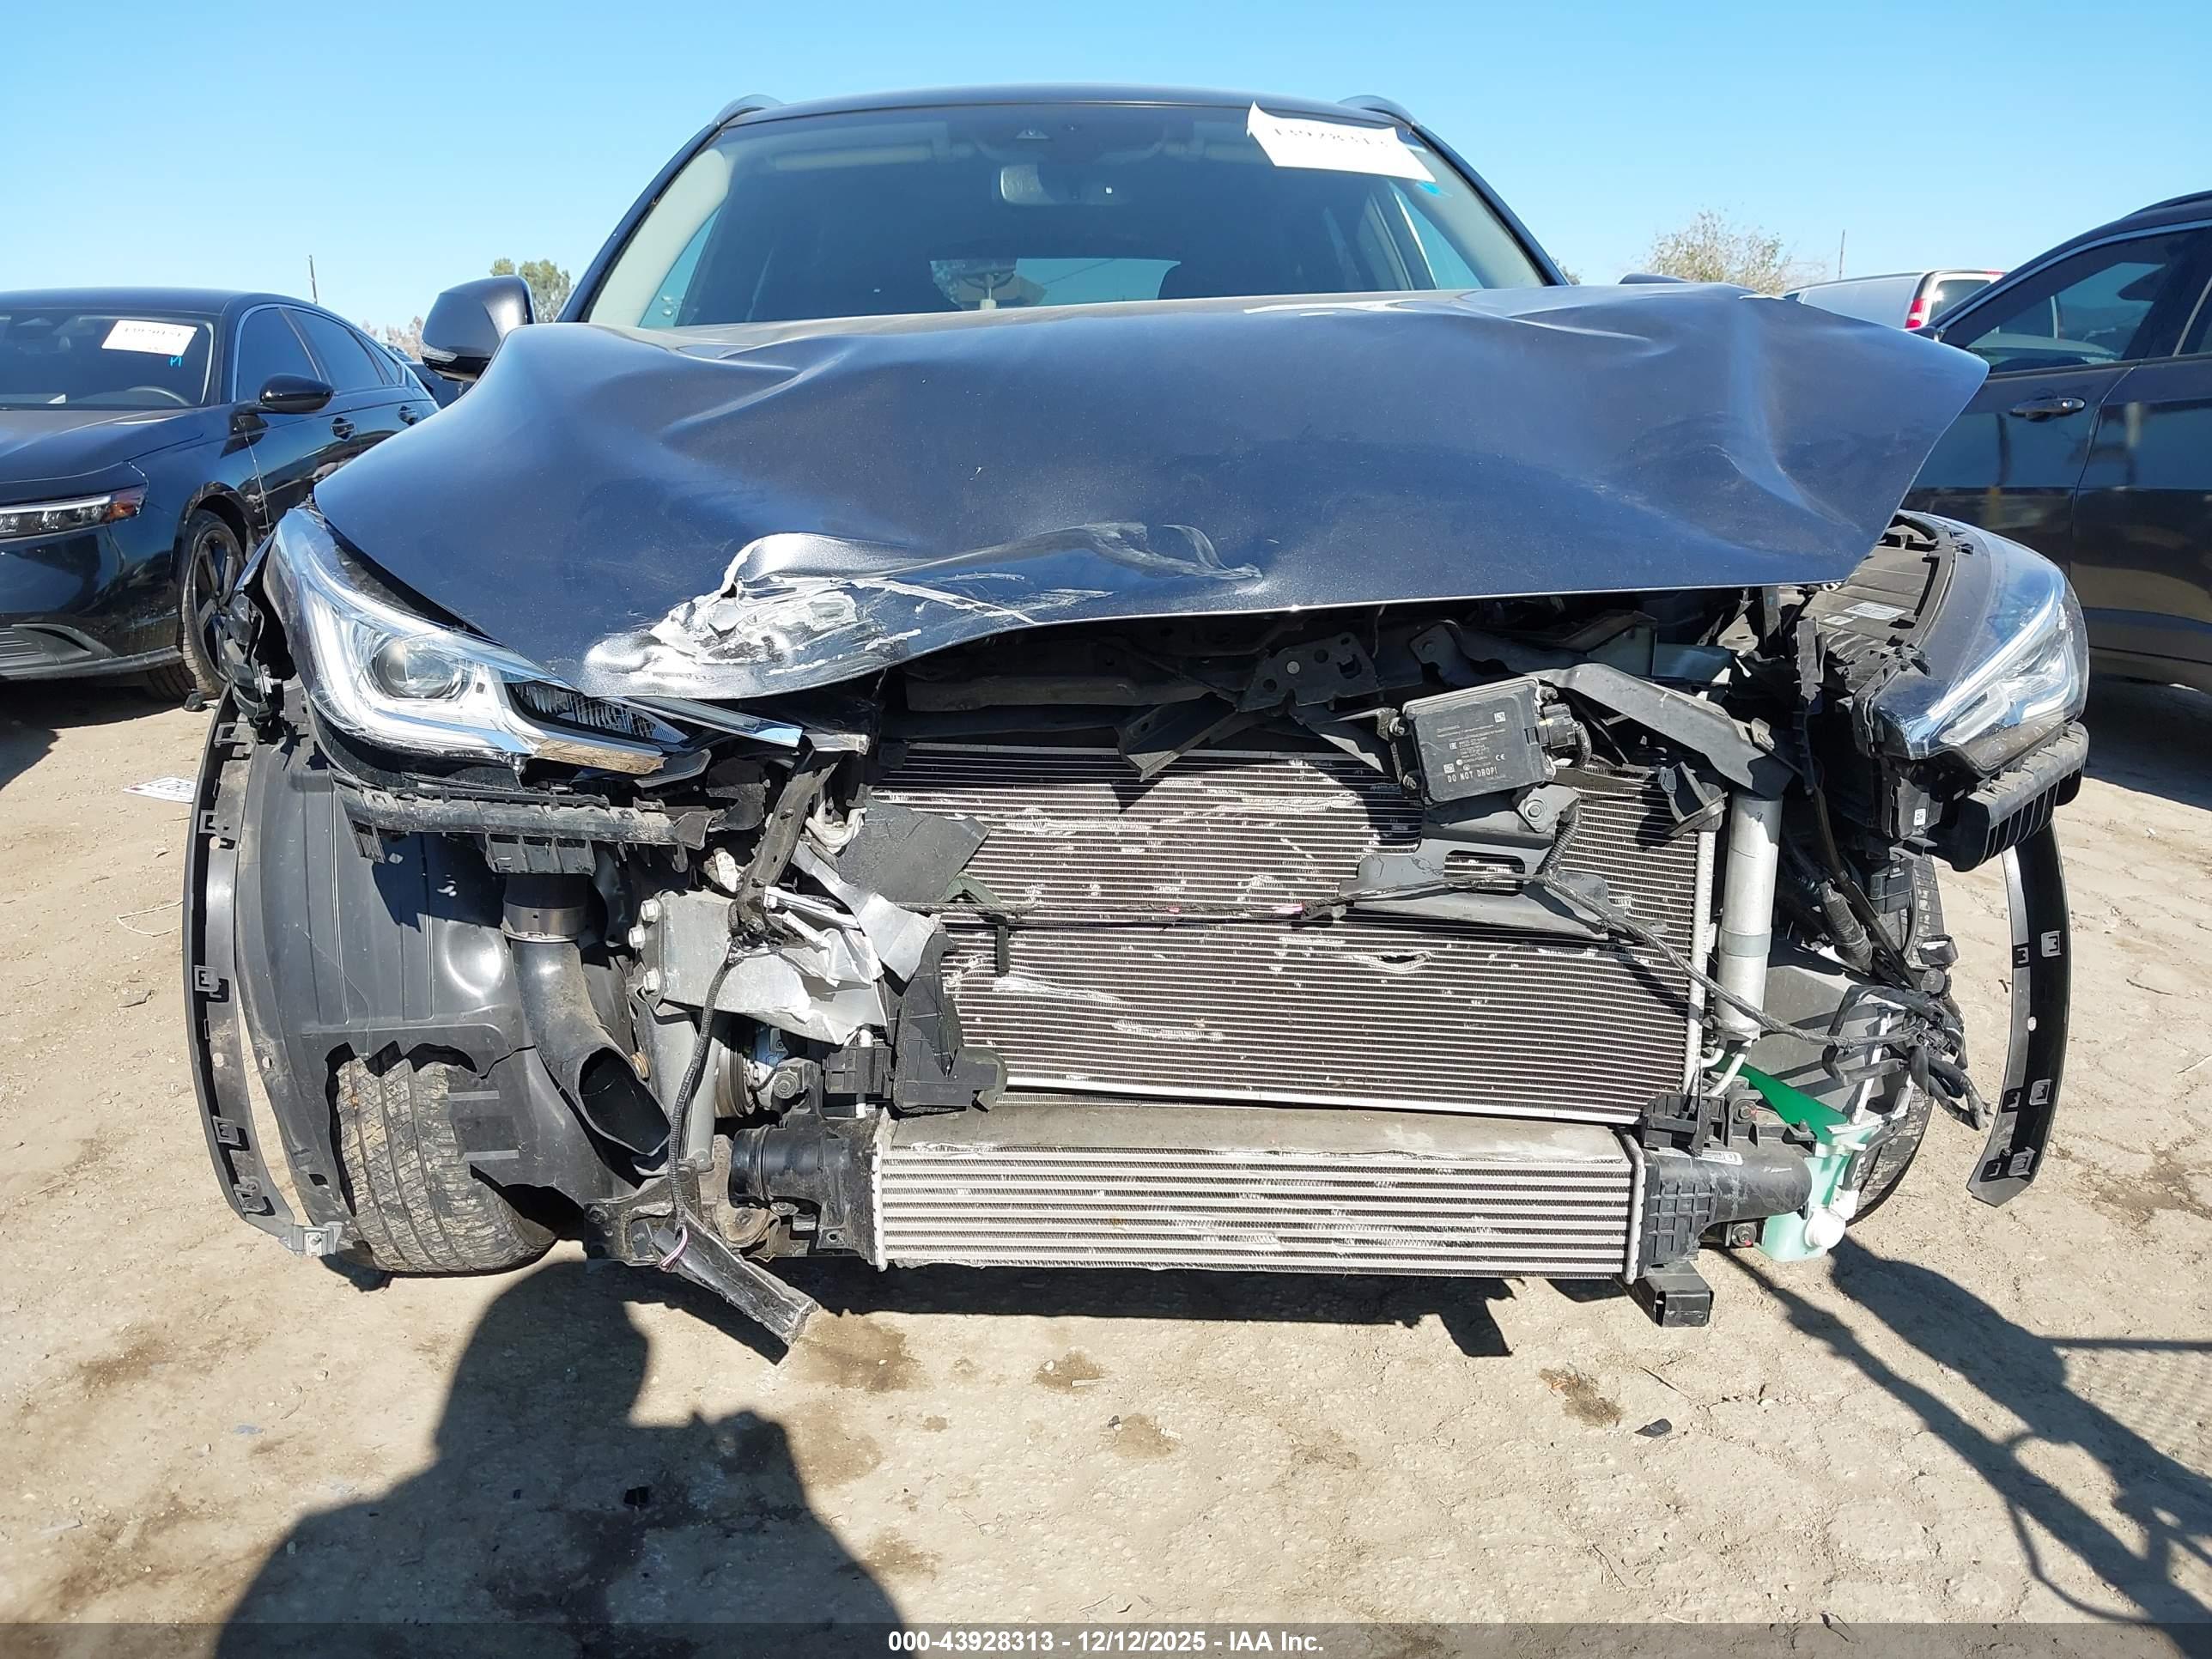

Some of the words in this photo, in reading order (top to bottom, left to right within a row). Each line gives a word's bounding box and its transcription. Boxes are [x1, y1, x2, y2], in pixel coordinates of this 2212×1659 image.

[1447, 774, 1457, 783] DO
[1460, 770, 1474, 781] NOT
[1477, 766, 1498, 777] DROP!
